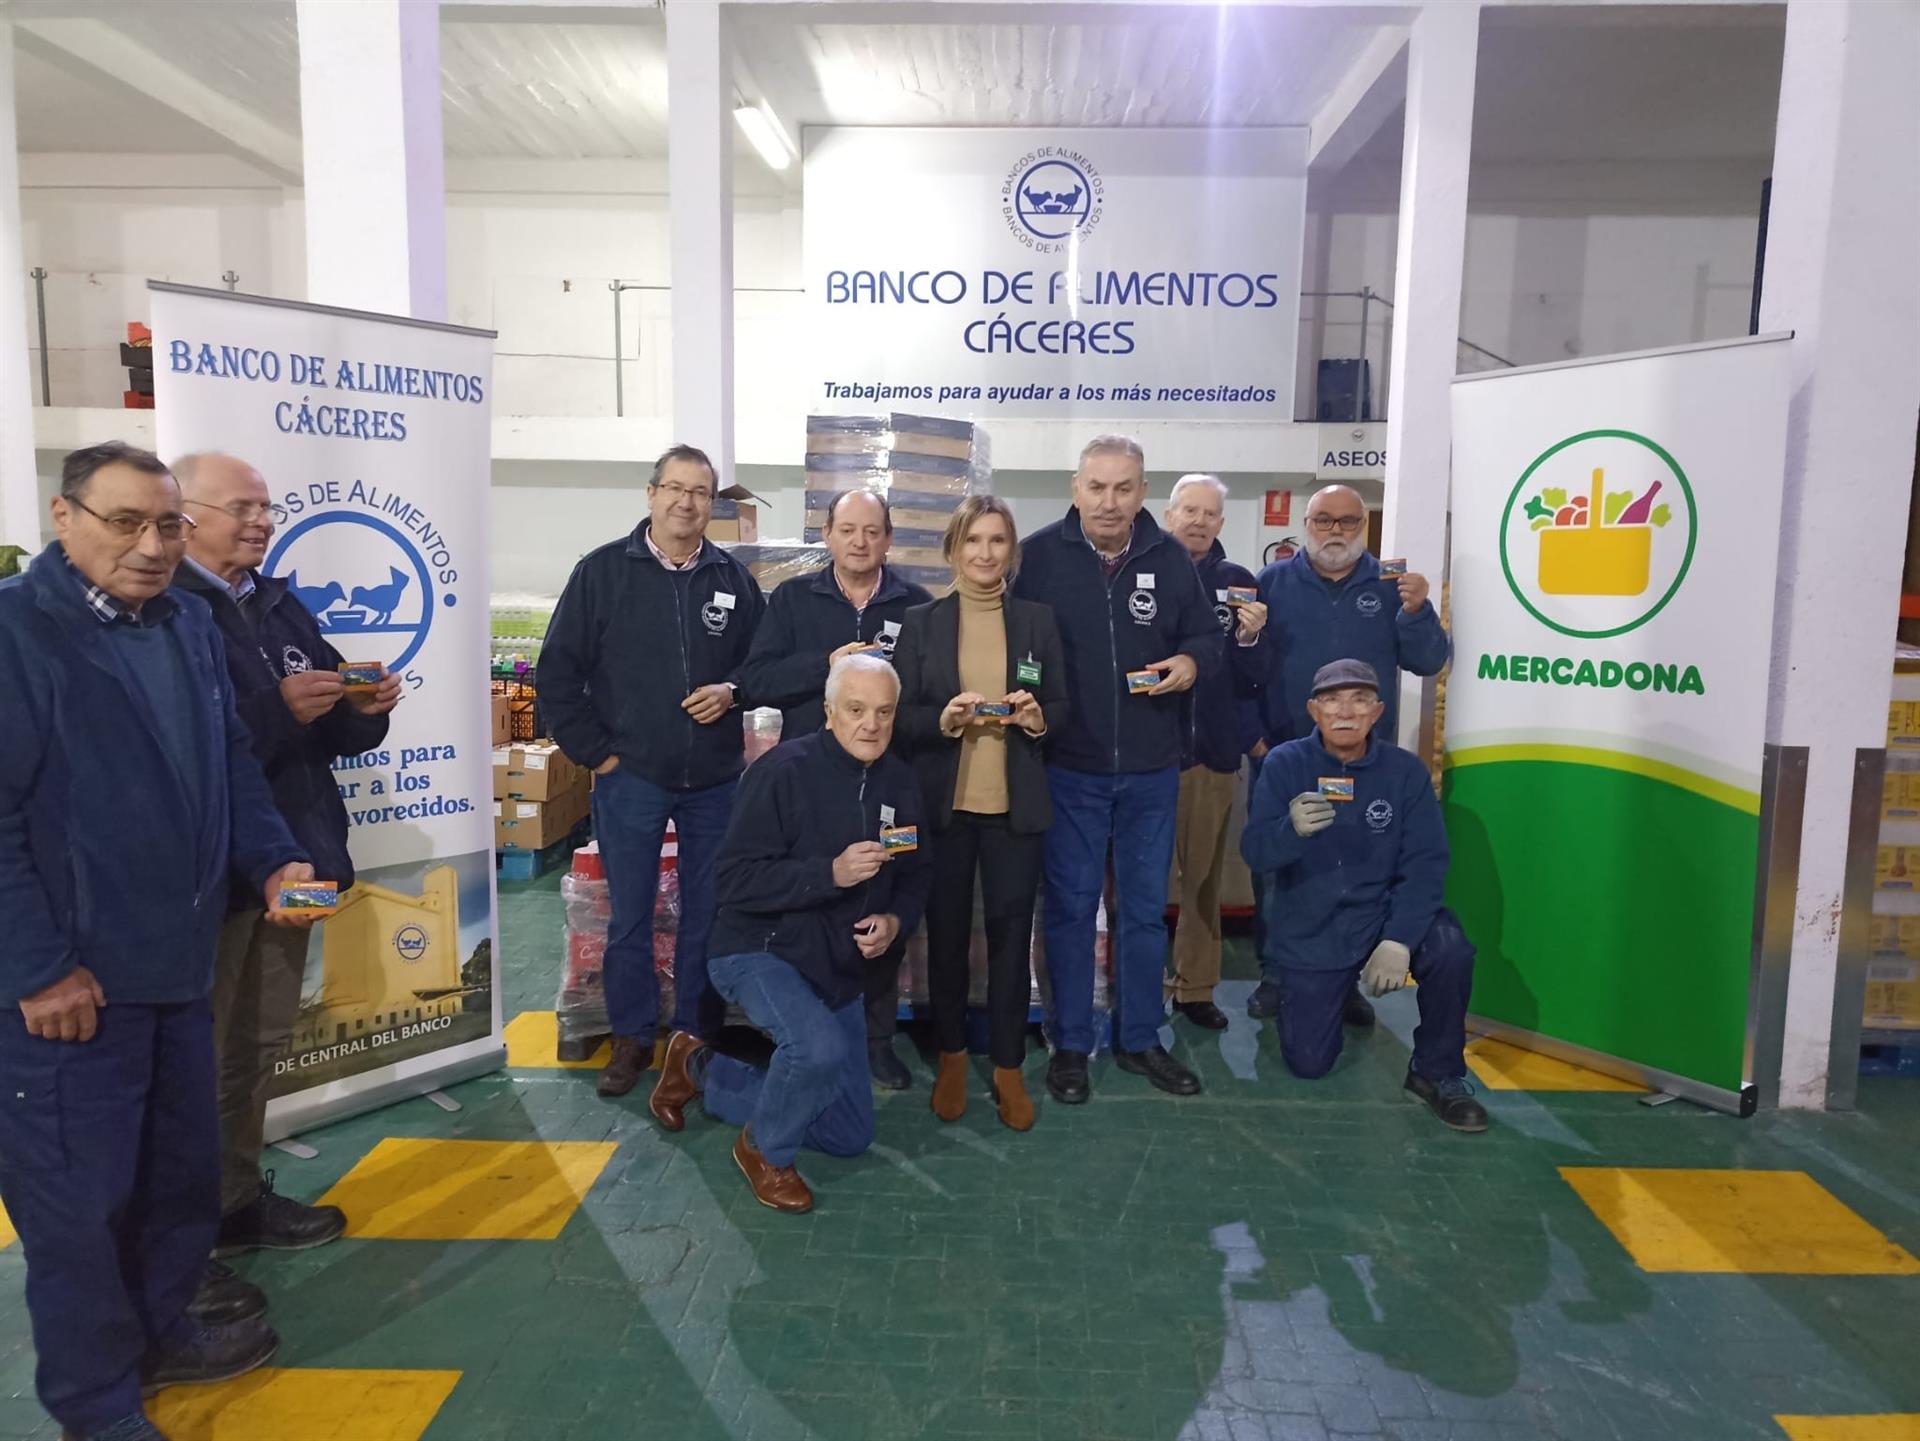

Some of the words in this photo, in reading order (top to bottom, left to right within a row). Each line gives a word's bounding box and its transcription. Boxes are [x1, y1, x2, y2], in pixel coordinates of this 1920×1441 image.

[1002, 152, 1036, 195] BANCOS
[1037, 146, 1053, 158] DE
[1056, 147, 1104, 195] ALIMENTOS
[1003, 206, 1034, 248] BANCOS
[1036, 242, 1051, 254] DE
[1055, 206, 1103, 253] ANTOS
[826, 269, 968, 305] BANCO
[982, 270, 1034, 305] DE
[963, 312, 1136, 356] CÁCERES
[170, 339, 282, 383] BANCO
[290, 353, 329, 389] DE
[335, 359, 484, 404] ALIMENTOS
[823, 381, 934, 404] Trabajamos
[938, 385, 982, 405] para
[987, 383, 1055, 405] ayudar
[1059, 387, 1071, 401] a
[1076, 383, 1106, 401] los
[1111, 381, 1152, 402] más
[1156, 384, 1277, 403] necesitados
[275, 395, 407, 442] CÁCERES
[309, 481, 341, 506] DE
[347, 479, 458, 585] ALIMENTOS
[1477, 653, 1706, 696] MERCADONA
[400, 744, 457, 770] para
[338, 782, 361, 800] ar
[370, 779, 385, 796] a
[395, 771, 431, 793] los
[347, 795, 476, 828] vorecidos.
[300, 1037, 368, 1068] CENTRAL
[371, 1028, 399, 1048] DEL
[401, 1015, 452, 1039] BANCO
